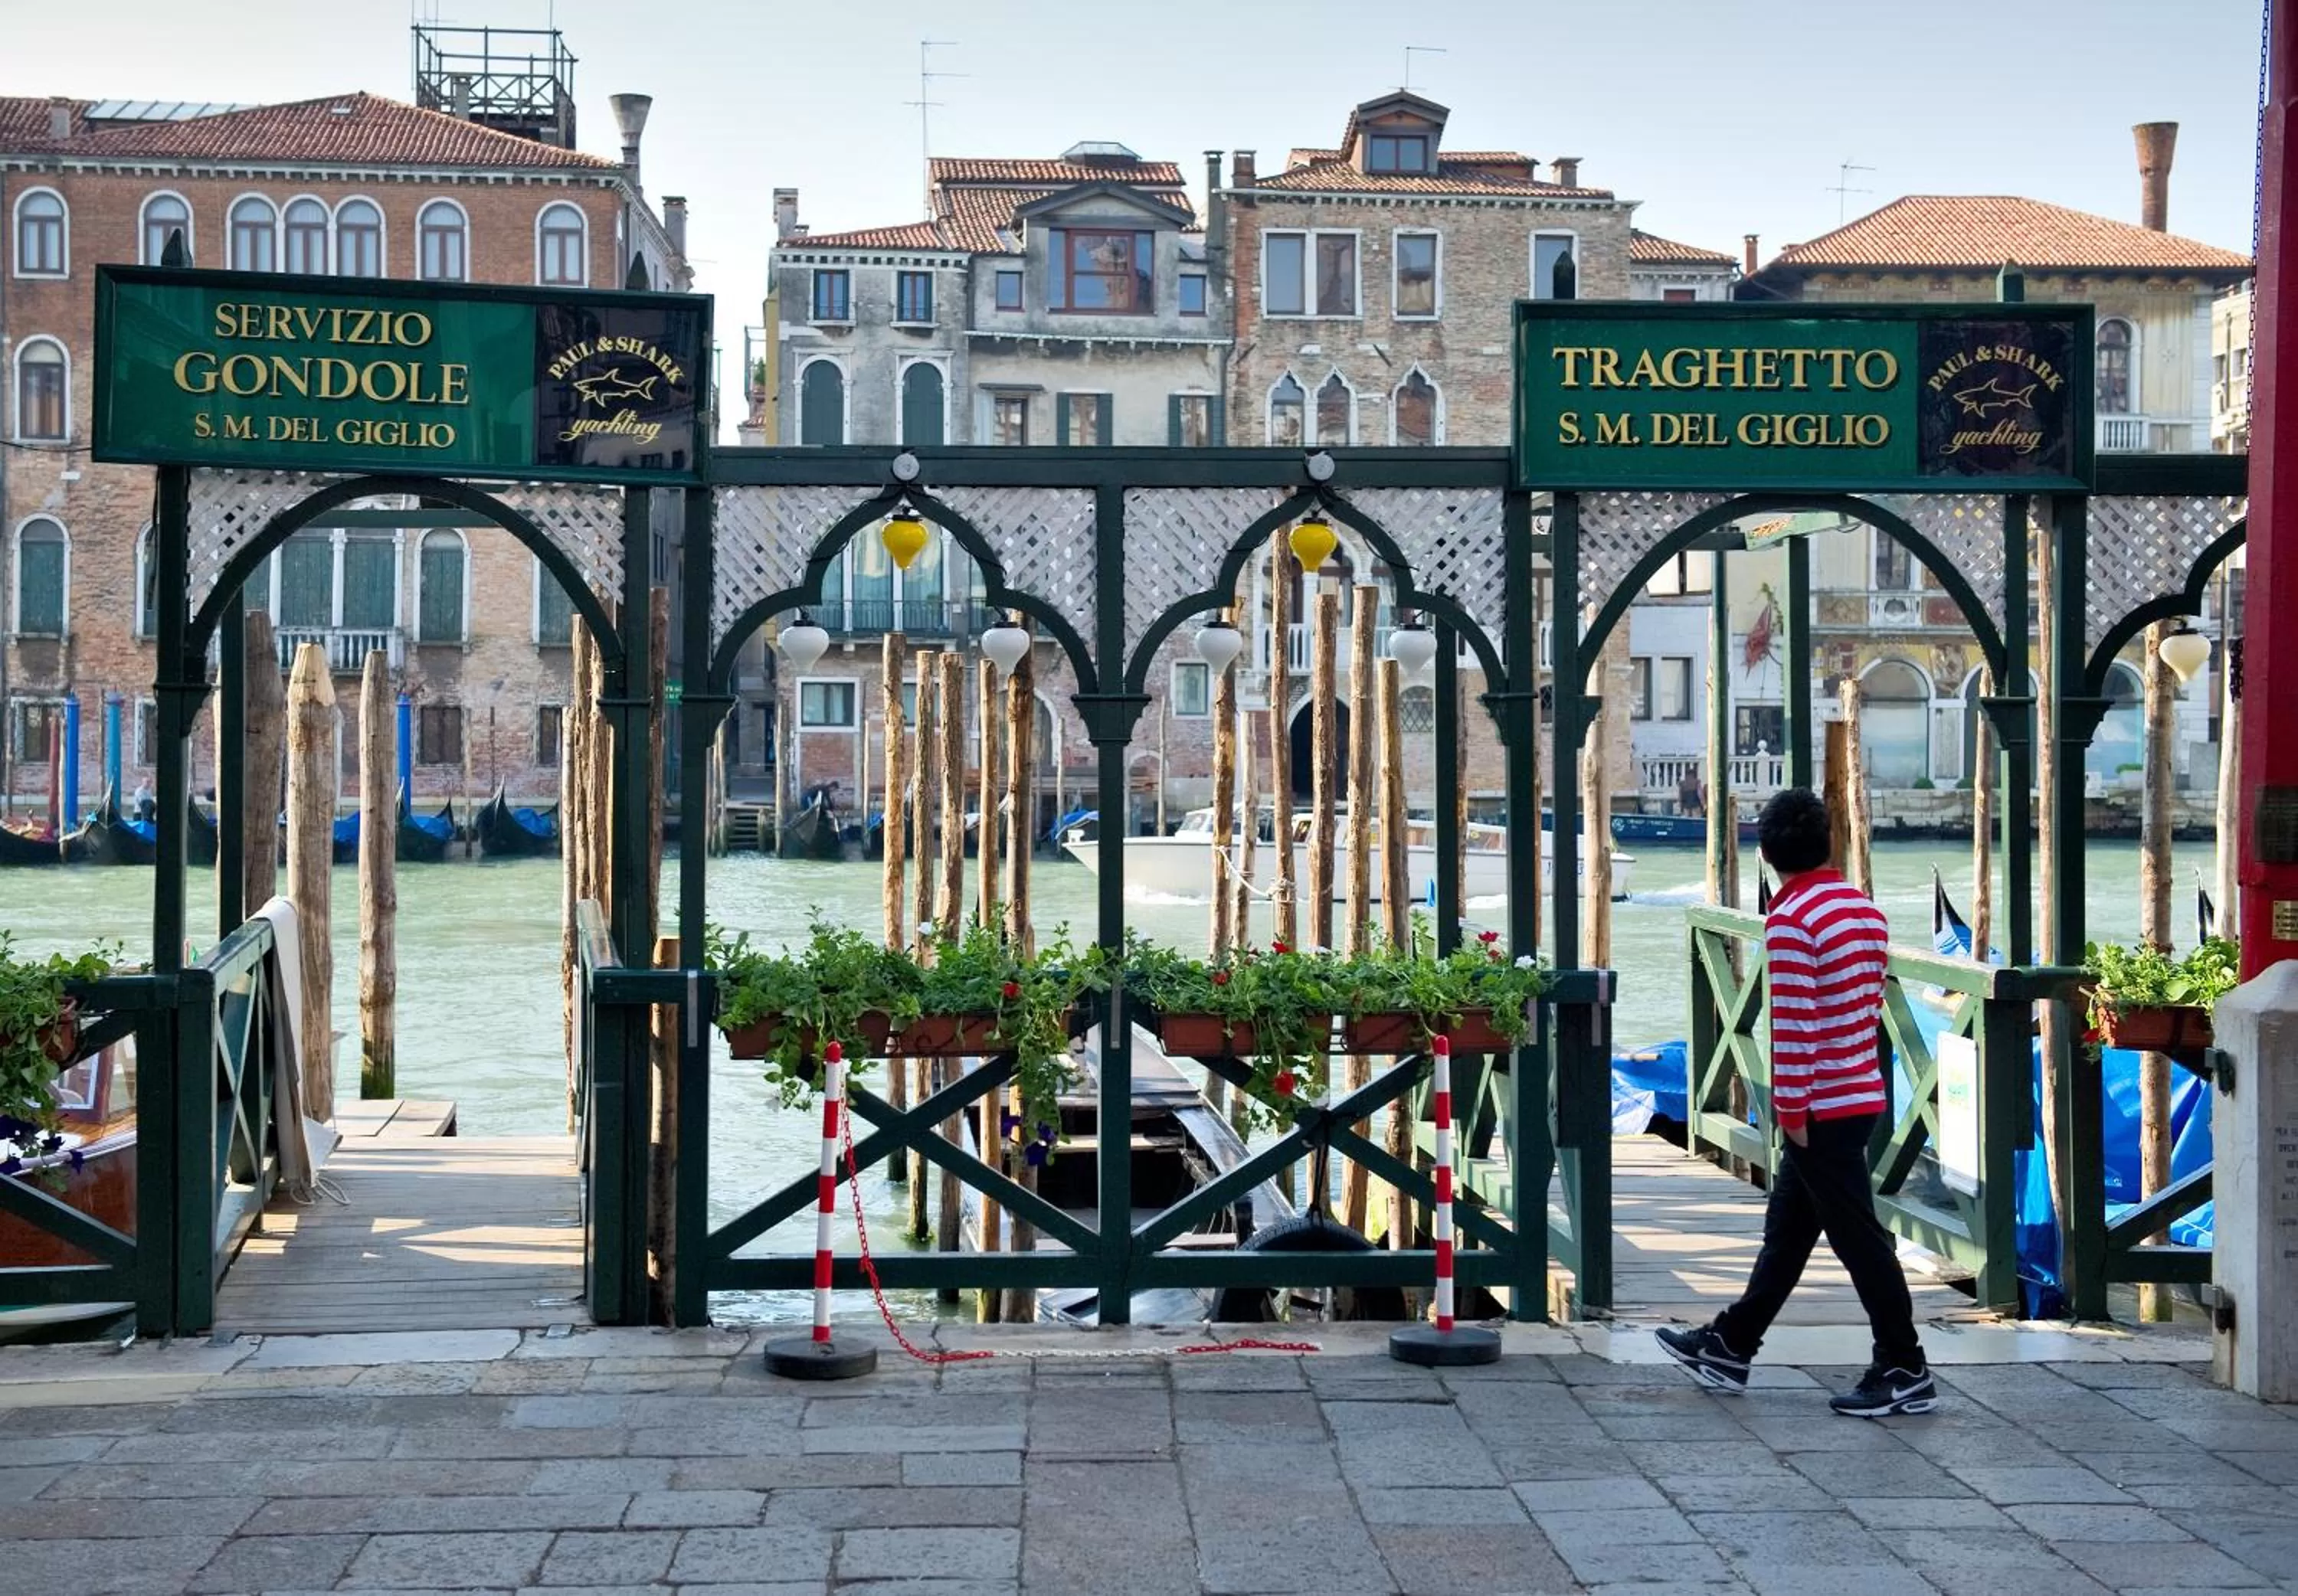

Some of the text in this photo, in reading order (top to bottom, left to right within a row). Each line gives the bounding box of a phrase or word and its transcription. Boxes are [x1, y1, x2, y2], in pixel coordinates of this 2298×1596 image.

[214, 303, 432, 346] SERVIZIO
[174, 351, 470, 405] GONDOLE
[548, 335, 686, 384] PAUL & SHARK
[1551, 347, 1898, 388] TRAGHETTO
[1927, 345, 2064, 392] PAUL & SHARK
[195, 412, 456, 448] S. M. DEL GIGLIO
[558, 408, 663, 445] yachting
[1559, 411, 1890, 446] S. M. DEL GIGLIO
[1939, 417, 2044, 454] yachting
